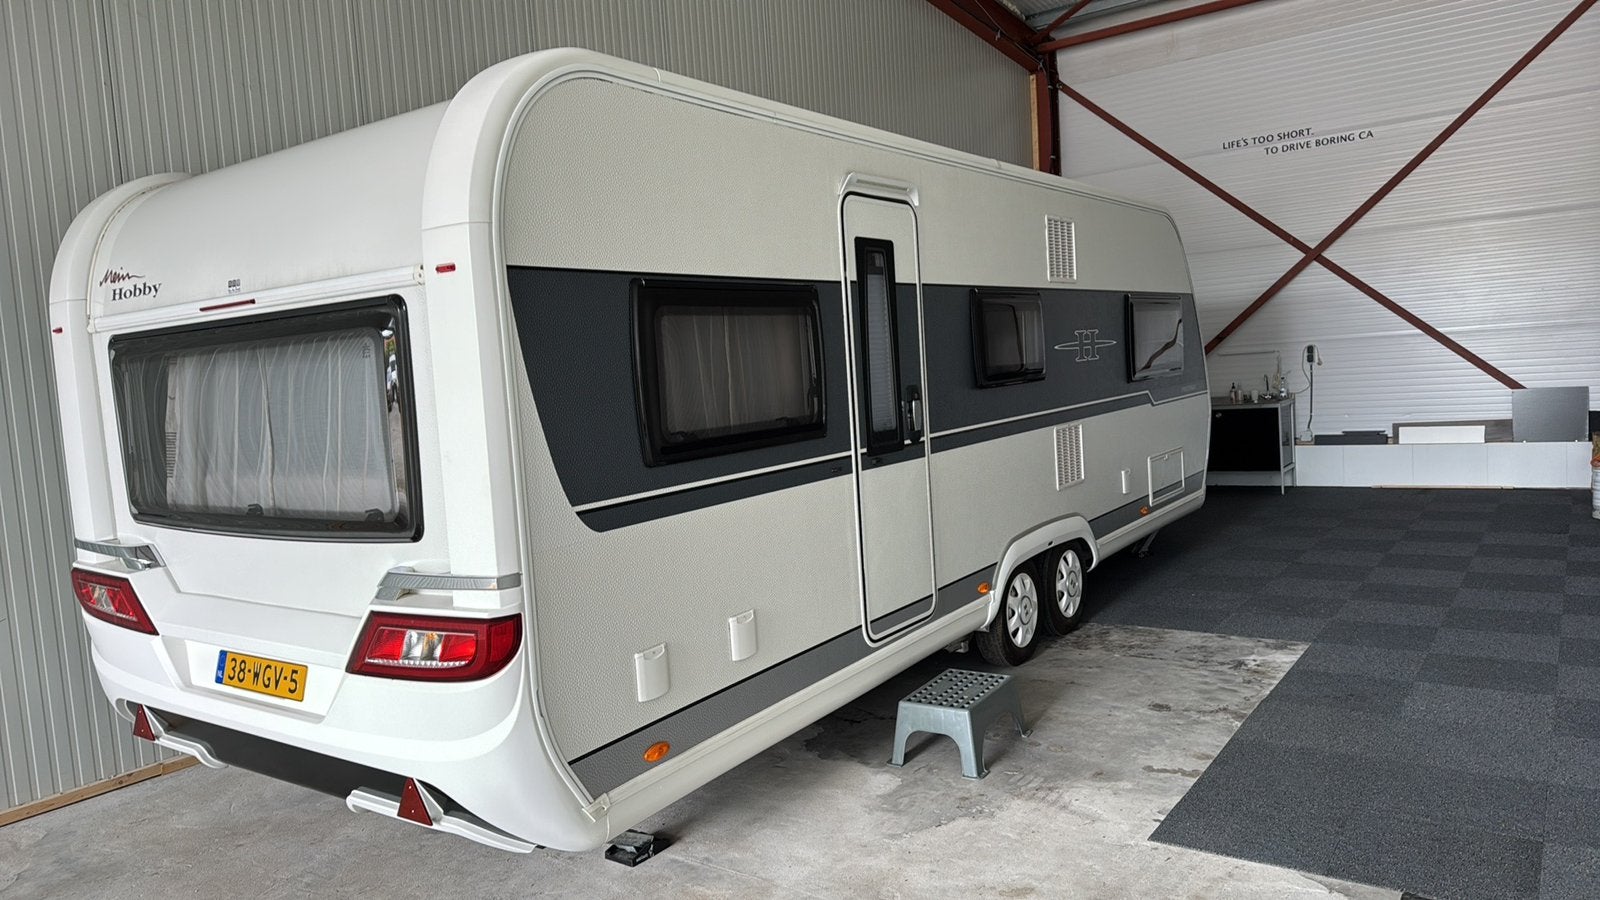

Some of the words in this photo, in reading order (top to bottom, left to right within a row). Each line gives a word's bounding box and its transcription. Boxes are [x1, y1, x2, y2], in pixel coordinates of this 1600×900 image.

[1222, 137, 1249, 150] LIFE'S
[1251, 134, 1274, 145] TOO
[1263, 146, 1279, 156] TO
[1281, 140, 1312, 153] DRIVE
[1315, 132, 1355, 147] BORING
[1358, 130, 1374, 140] CA
[111, 282, 162, 301] Hobby
[228, 657, 299, 694] 38-WGV-5
